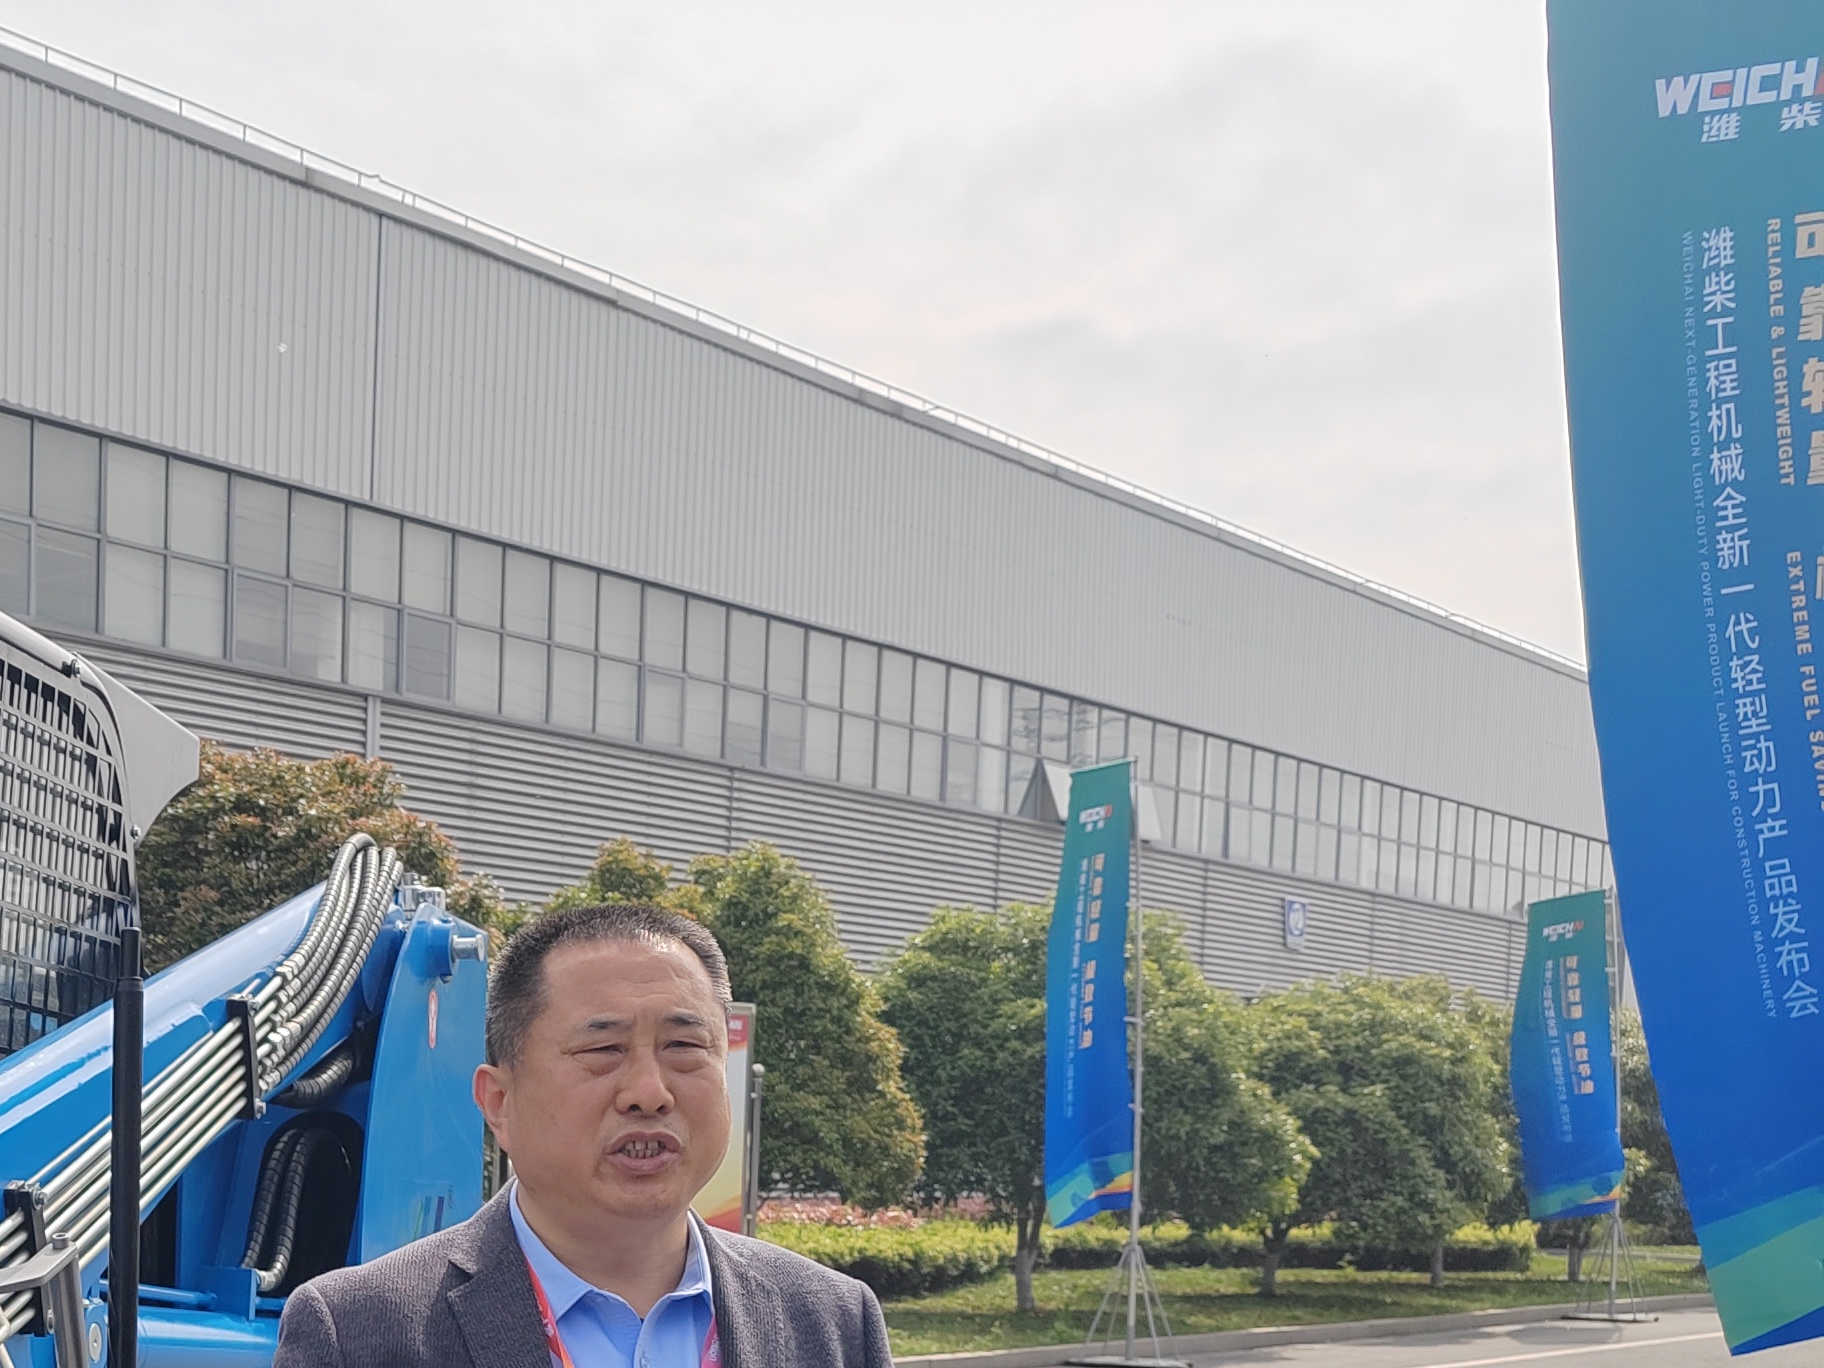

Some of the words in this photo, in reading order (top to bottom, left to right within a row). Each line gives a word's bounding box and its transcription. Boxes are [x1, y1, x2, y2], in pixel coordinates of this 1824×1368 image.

[1682, 230, 1695, 302] WEICHAI
[1766, 217, 1785, 318] RELIABLE
[1770, 325, 1786, 340] &
[1771, 345, 1795, 487] LIGHTWEIGHT
[1699, 561, 1715, 618] POWER
[1701, 225, 1820, 1020] 潍柴工程机械全新一代轻型动力产品发布会
[1786, 550, 1813, 656] EXTREME
[1706, 623, 1725, 697] PRODUCT
[1799, 664, 1821, 722] FUEL
[1714, 702, 1734, 765] LAUNCH
[1726, 769, 1740, 801] FOR
[1730, 805, 1760, 926] CONSTRUCTION
[1752, 929, 1777, 1018] MACHINERY
